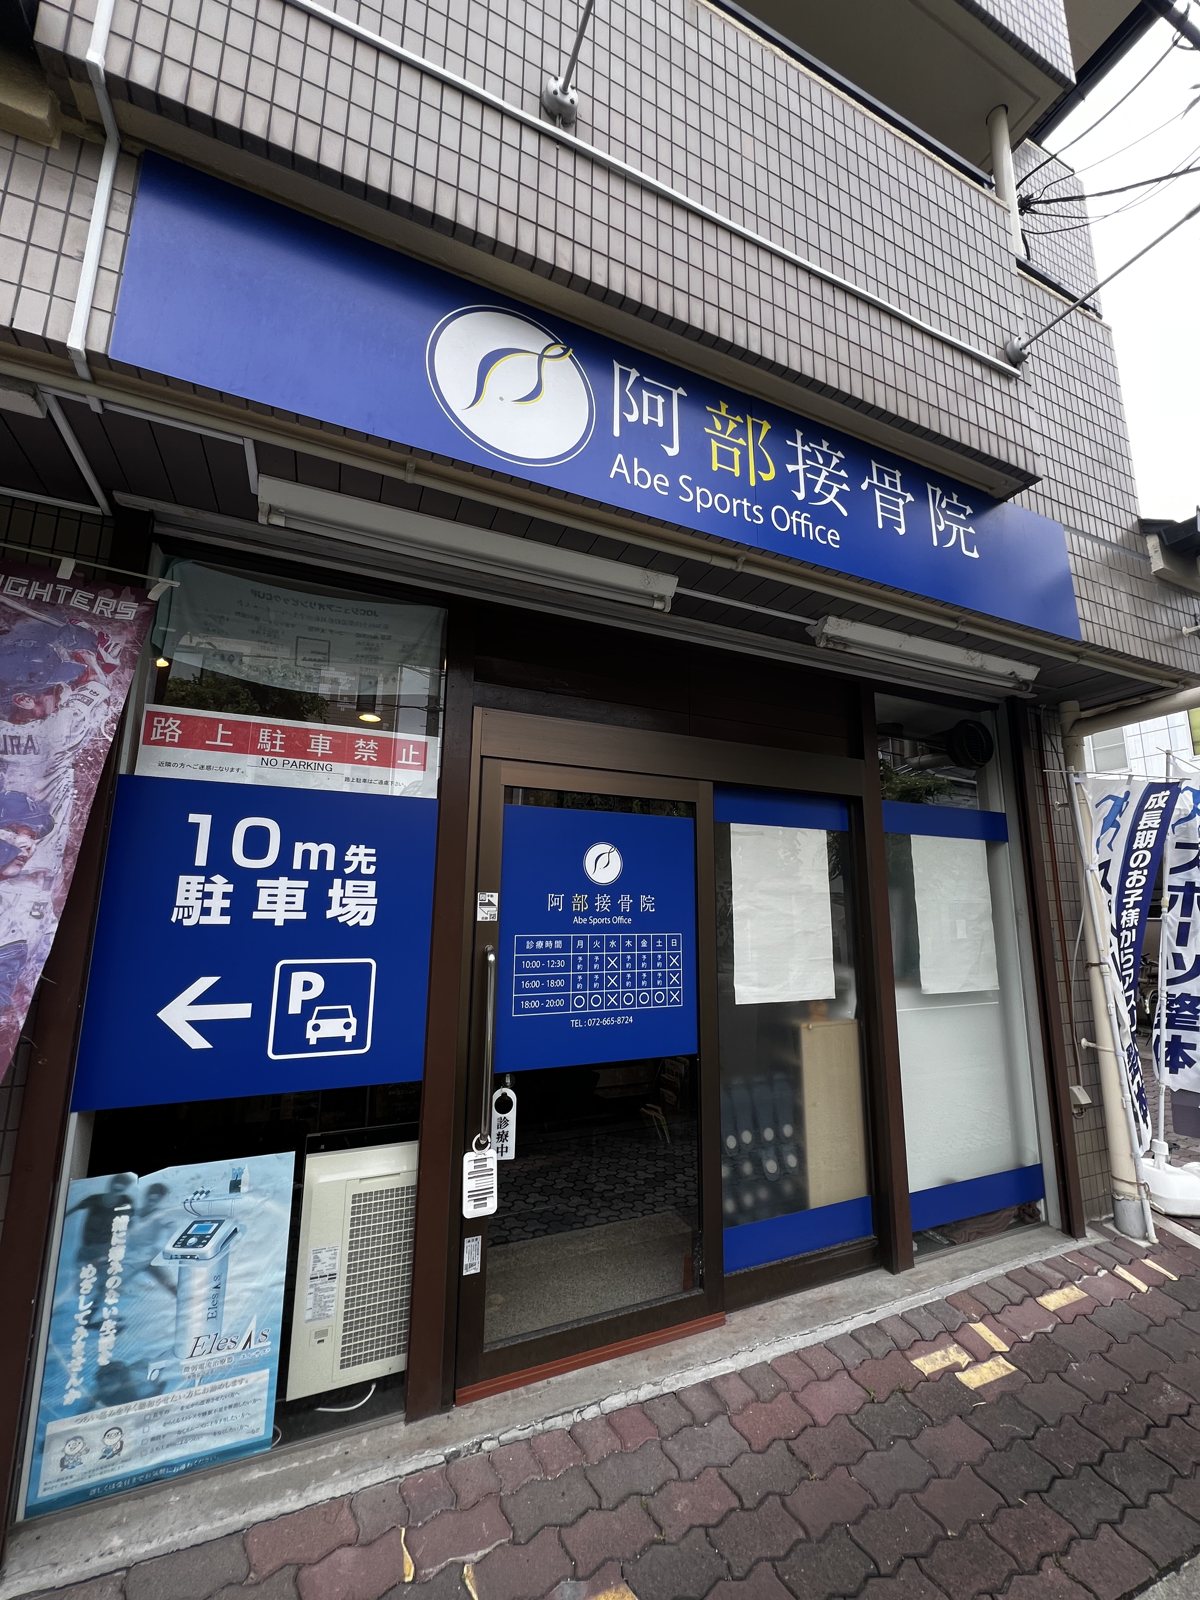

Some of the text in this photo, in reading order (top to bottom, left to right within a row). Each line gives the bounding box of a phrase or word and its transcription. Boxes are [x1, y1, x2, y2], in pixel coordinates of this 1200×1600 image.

[611, 359, 980, 559] 阿部接骨院
[610, 453, 841, 550] Abe Sports Office
[150, 716, 422, 767] 路上駐車禁止
[157, 761, 245, 775] 近隣の方へご迷惑になります。
[260, 757, 333, 773] NO PARKING
[171, 874, 378, 927] 駐車場
[547, 893, 655, 913] 阿部接骨院
[572, 915, 632, 926] Abe Sports Office
[525, 938, 678, 950] 診療時間 月 火 水 木 金 土 日
[521, 960, 541, 969] 10:00
[546, 959, 566, 968] 12:30
[287, 971, 326, 1015] P
[521, 980, 541, 989] 16:00
[546, 979, 565, 988] 18:00
[520, 1000, 540, 1009] 18:00
[545, 998, 565, 1008] 20:00
[495, 1116, 510, 1158] 診療中
